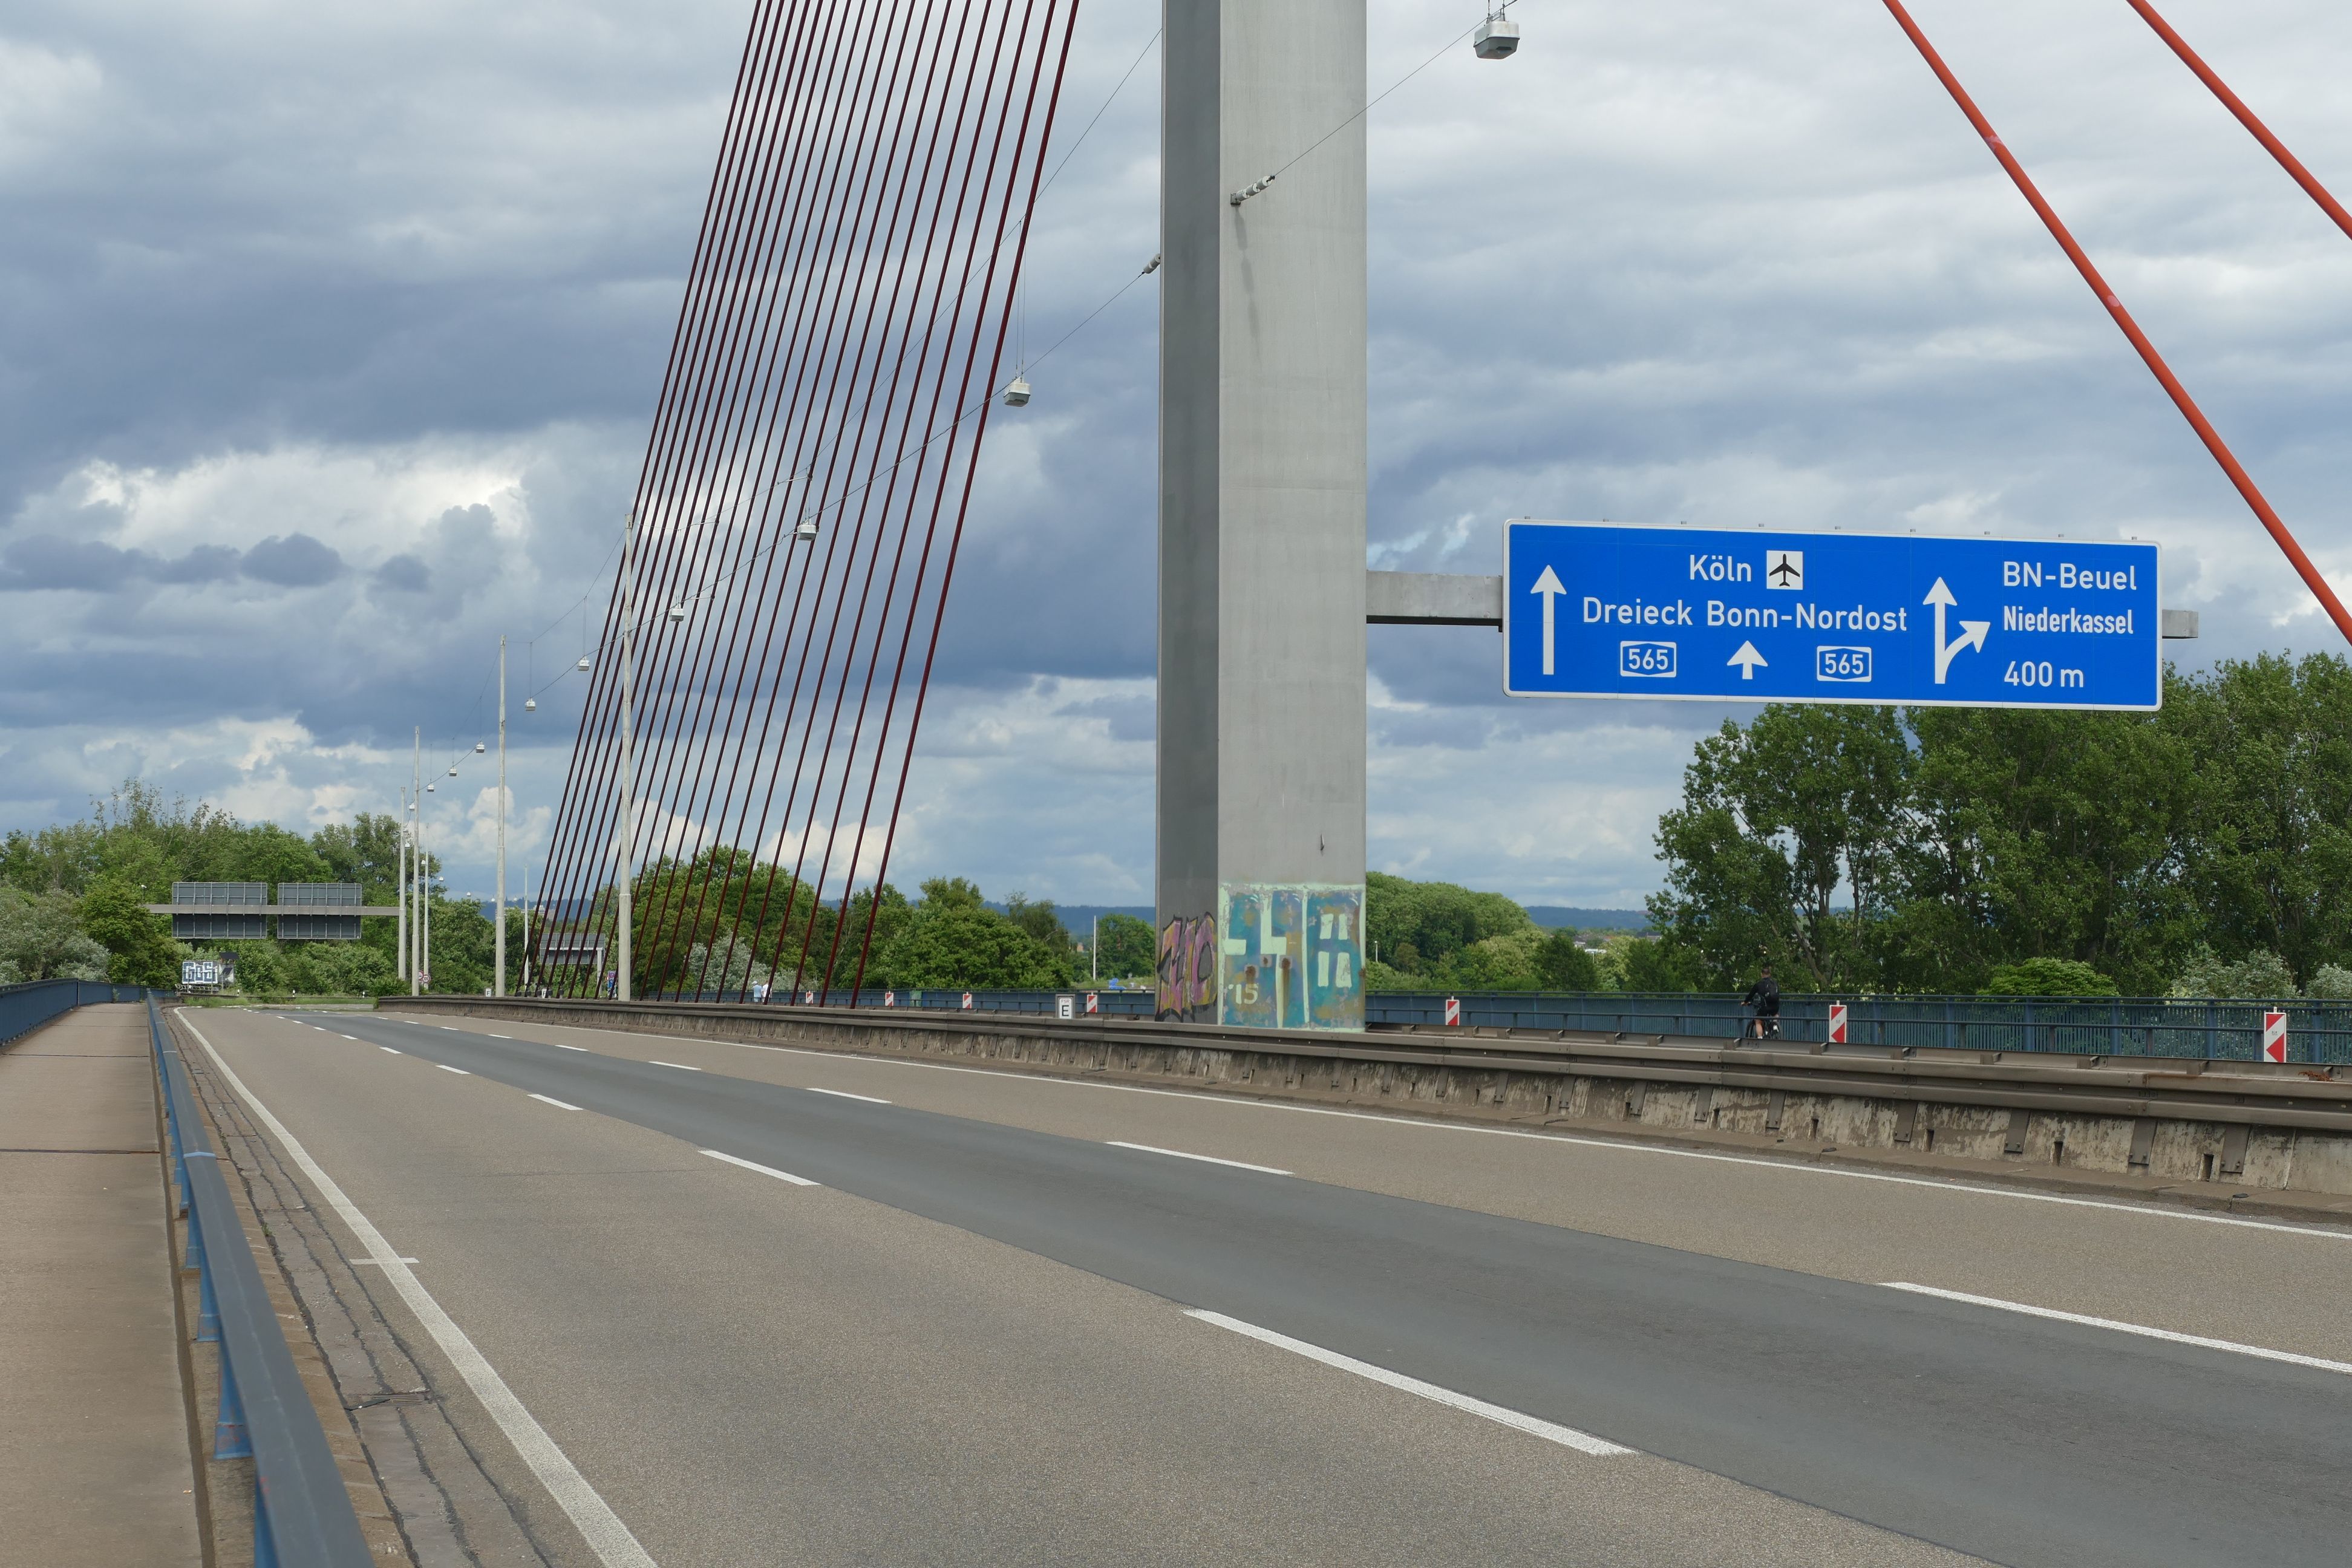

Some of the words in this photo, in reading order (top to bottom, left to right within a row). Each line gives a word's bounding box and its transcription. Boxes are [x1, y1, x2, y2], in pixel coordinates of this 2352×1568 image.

[1690, 555, 1751, 582] Köln
[2004, 561, 2137, 590] BN-Beuel
[1584, 596, 1693, 626] Dreieck
[1708, 601, 1907, 631] Bonn-Nordost
[2004, 606, 2134, 634] Niederkassel
[1628, 648, 1668, 670] 565
[1825, 653, 1864, 675] 565
[2005, 661, 2052, 687] 400
[2061, 670, 2083, 688] m
[1062, 1005, 1069, 1016] E
